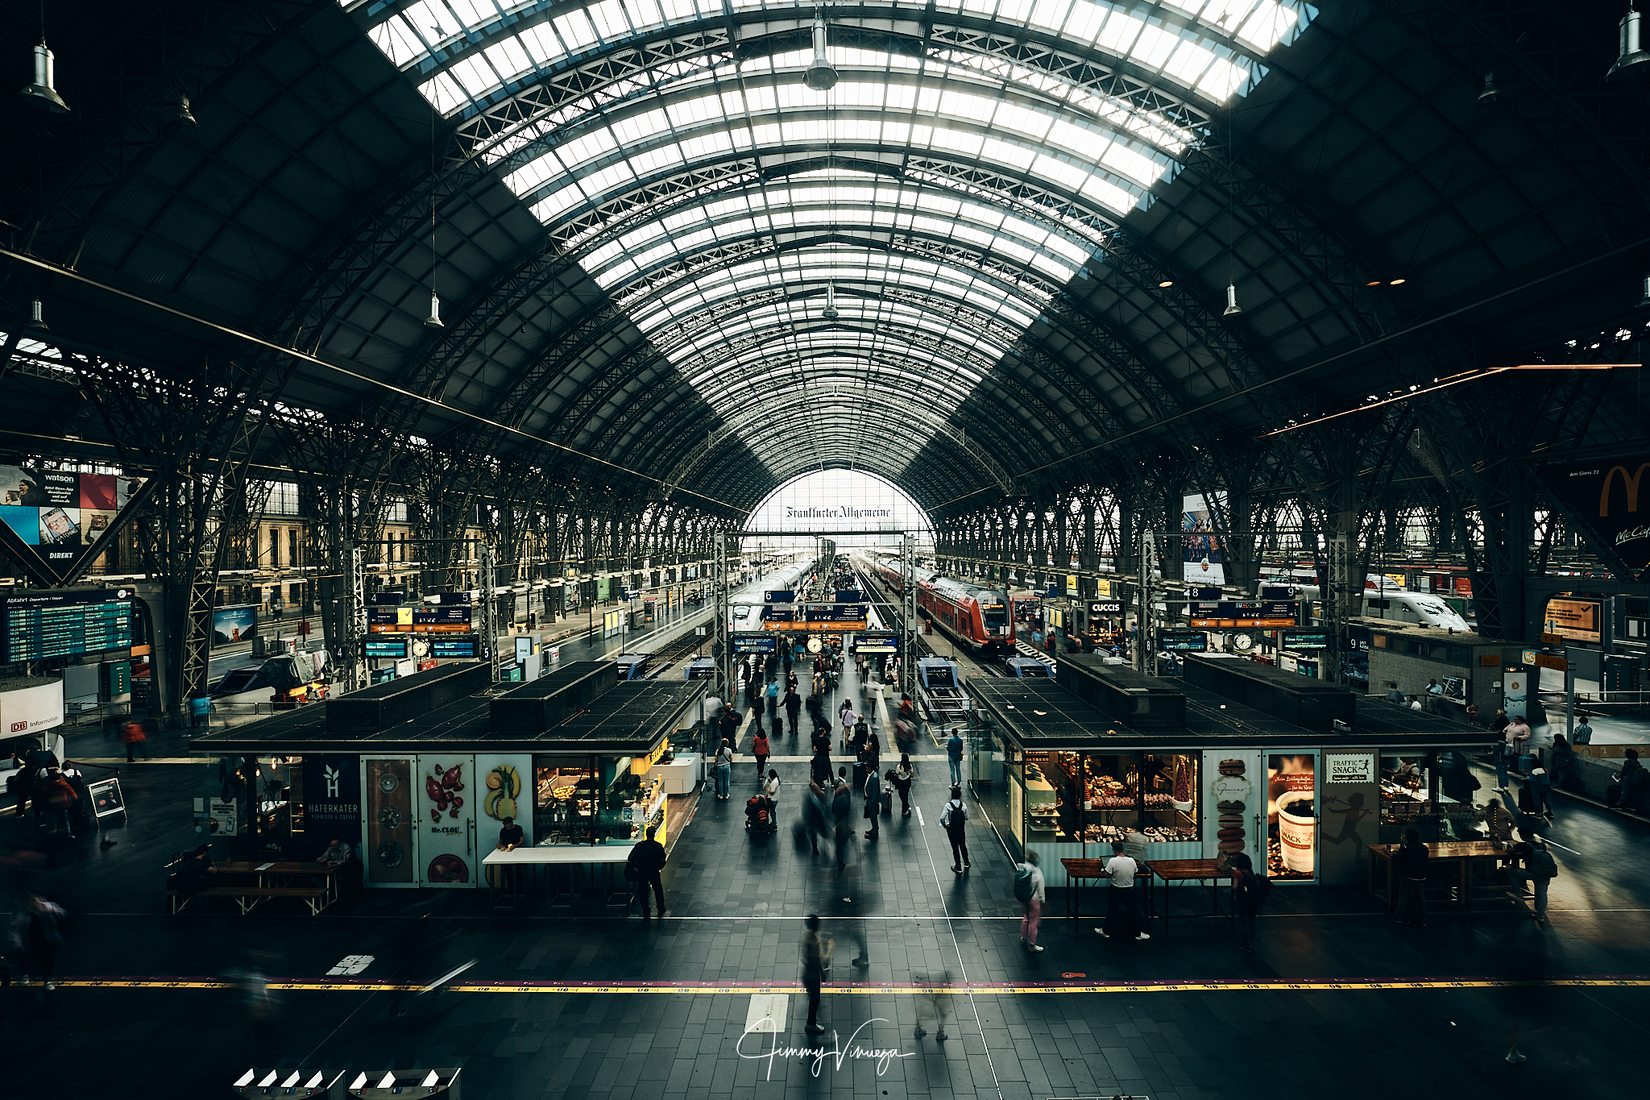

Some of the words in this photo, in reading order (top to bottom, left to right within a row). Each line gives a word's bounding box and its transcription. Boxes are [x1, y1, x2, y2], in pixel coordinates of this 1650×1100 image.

[44, 474, 74, 483] watson
[786, 506, 837, 518] Frankfurter
[839, 506, 890, 519] Allgemeine
[765, 592, 772, 600] 6
[859, 592, 865, 600] 7
[1192, 588, 1199, 597] 8
[1288, 588, 1294, 596] 9
[370, 594, 377, 603] 4
[462, 593, 468, 602] 5
[1092, 603, 1120, 612] CUCCIS
[1146, 641, 1151, 651] 8
[1350, 638, 1356, 649] 9
[337, 648, 342, 658] 4
[484, 648, 489, 659] 5
[12, 722, 26, 731] DB
[30, 716, 58, 728] Information
[308, 804, 358, 813] HAFERKATER
